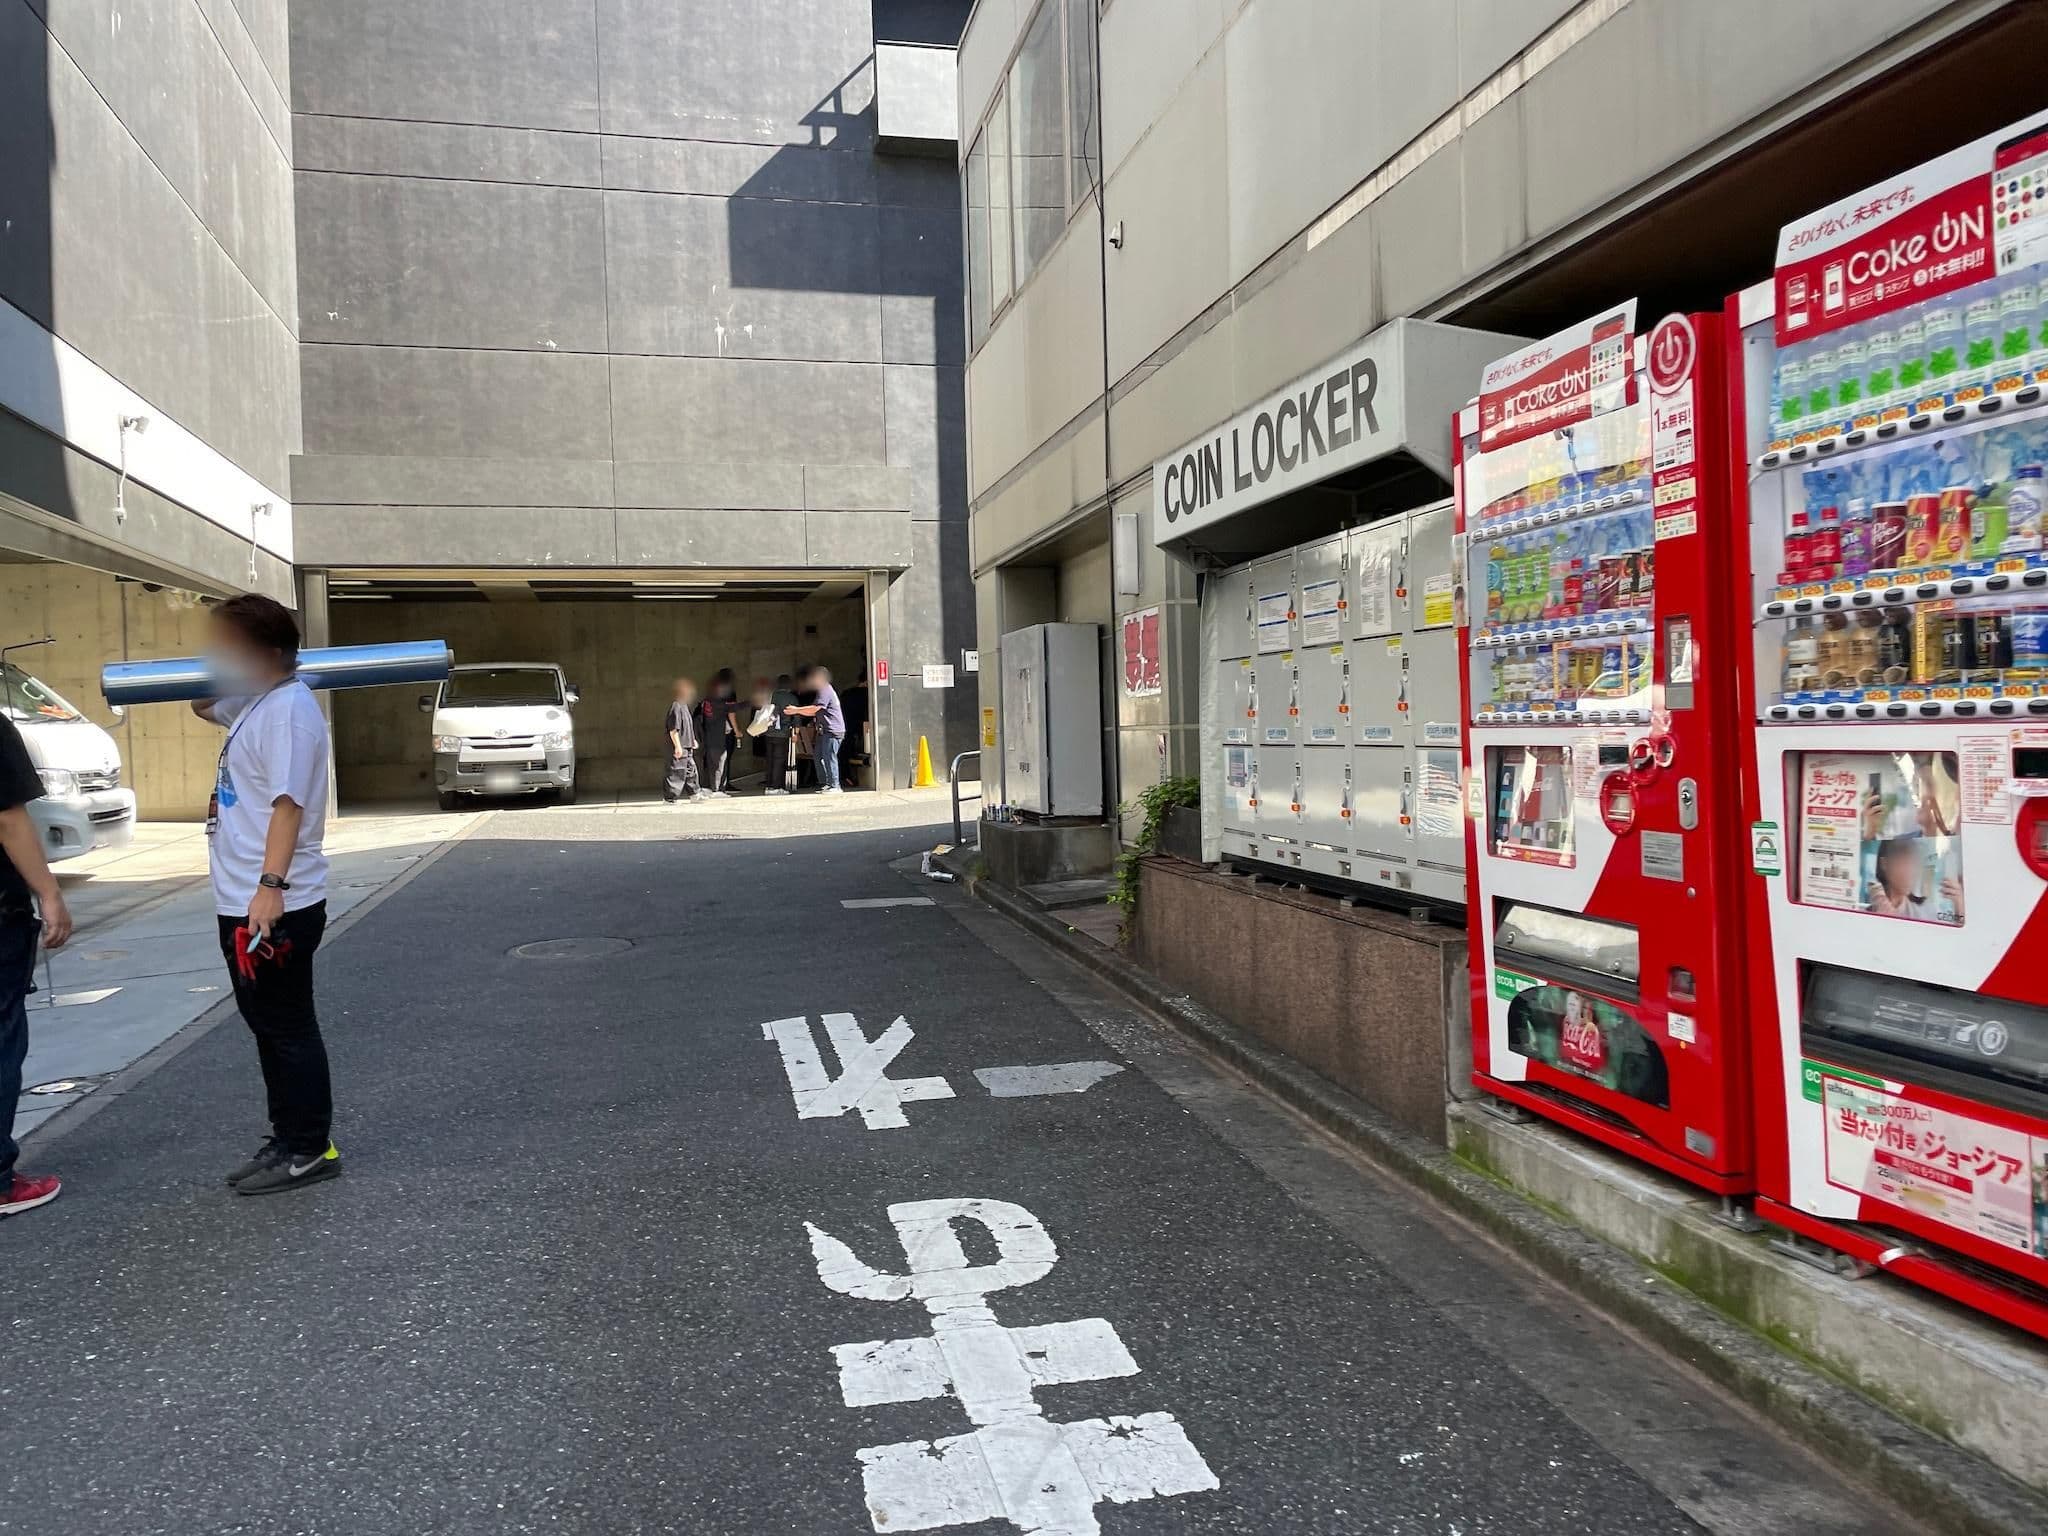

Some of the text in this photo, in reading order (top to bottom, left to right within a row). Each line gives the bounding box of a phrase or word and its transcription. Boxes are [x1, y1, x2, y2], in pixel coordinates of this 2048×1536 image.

[1788, 186, 1914, 251] さりげなく、未来です。
[1847, 204, 1985, 285] Coke ON
[1516, 368, 1588, 414] Coke ON
[1163, 357, 1380, 523] COIN LOCKER
[1808, 787, 1857, 806] ジョージア
[1839, 1106, 1918, 1152] 当たり付き
[1923, 1130, 2023, 1185] ジョージア
